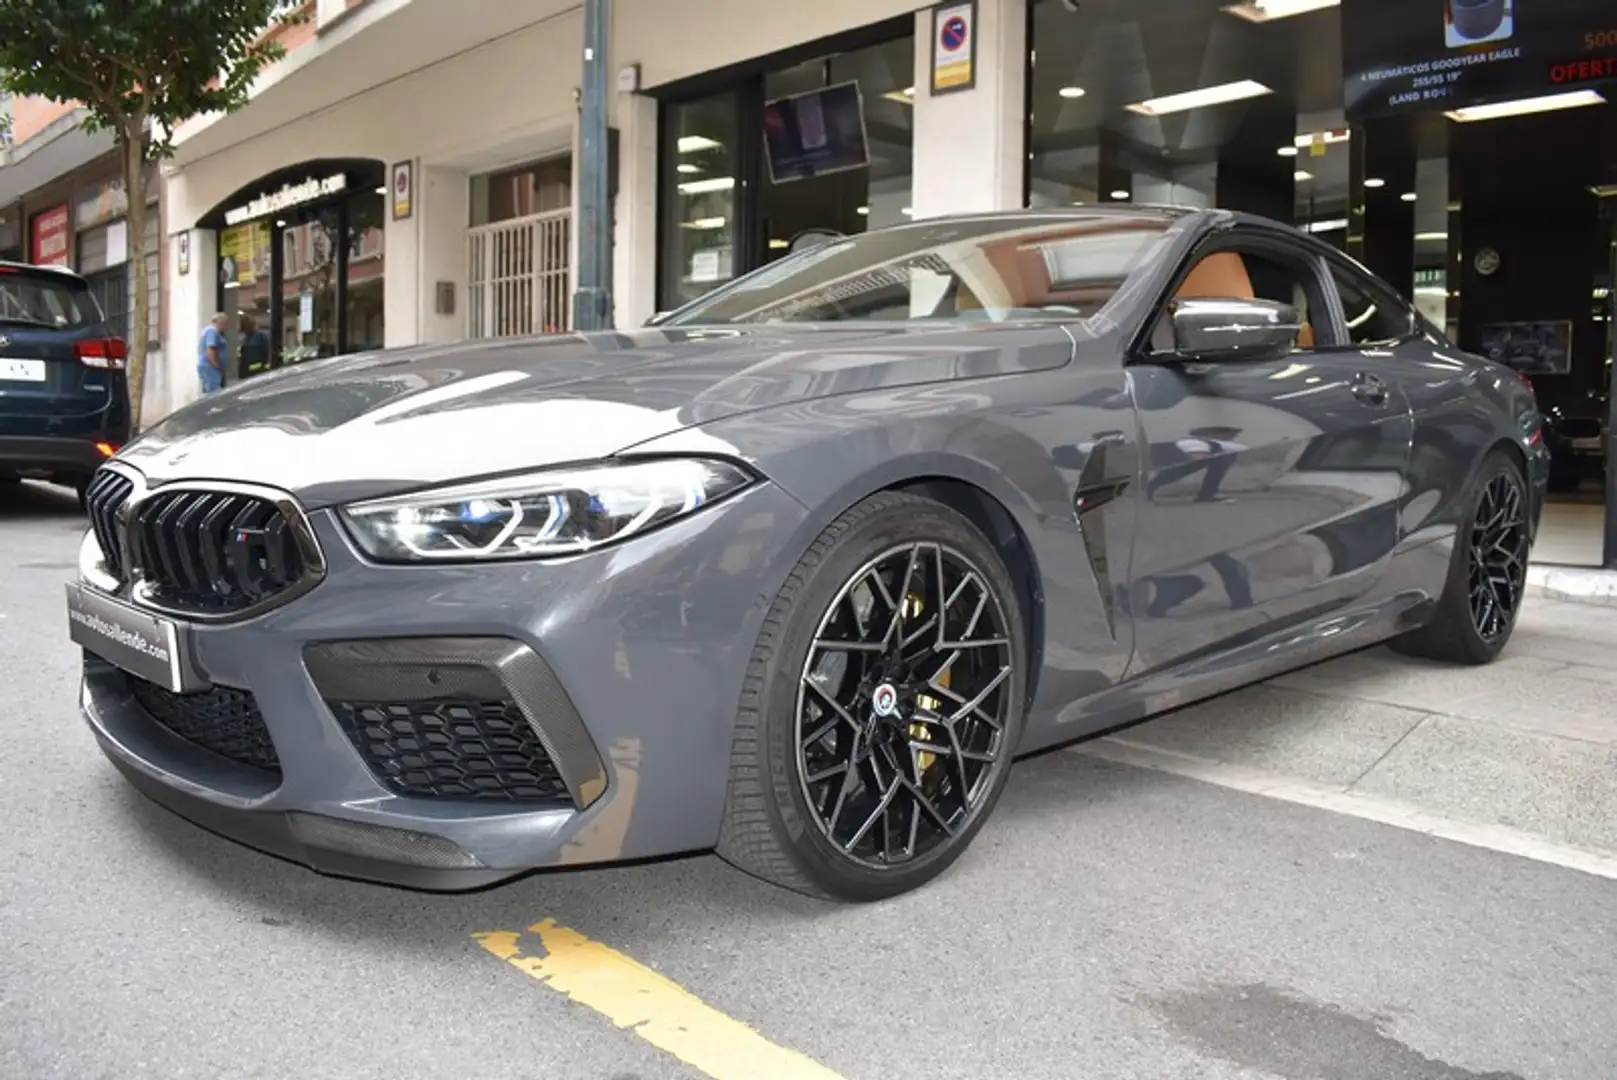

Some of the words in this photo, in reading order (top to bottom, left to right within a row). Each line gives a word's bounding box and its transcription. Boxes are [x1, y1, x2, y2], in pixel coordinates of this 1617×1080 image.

[1431, 53, 1486, 71] GOODYEAR
[1488, 47, 1520, 62] EAGLE
[1550, 57, 1617, 82] OFERT
